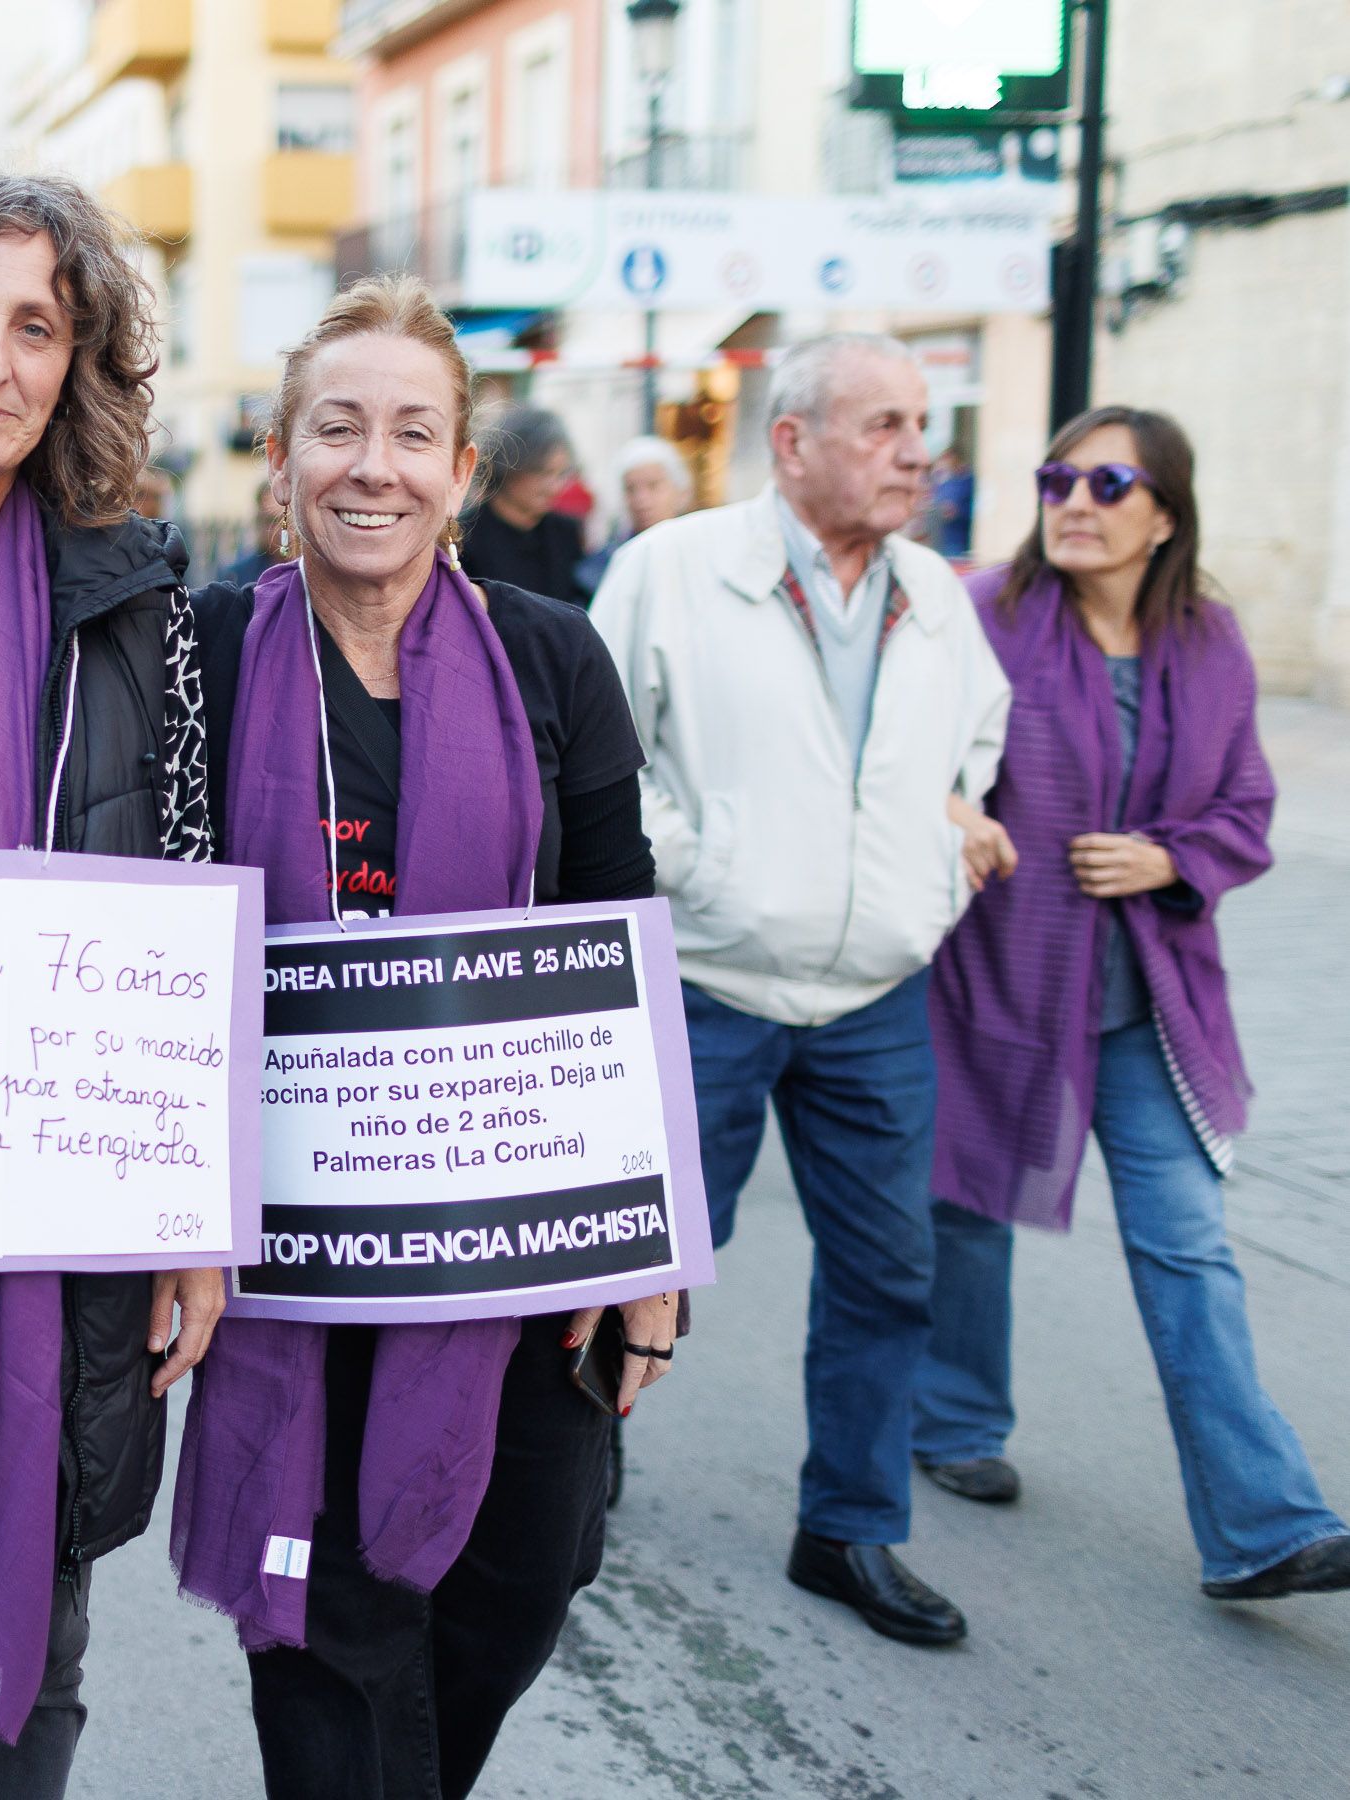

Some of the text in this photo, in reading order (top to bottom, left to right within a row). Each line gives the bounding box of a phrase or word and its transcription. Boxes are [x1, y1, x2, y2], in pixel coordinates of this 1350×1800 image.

[39, 933, 103, 992] 76
[117, 950, 207, 999] años
[343, 958, 443, 987] ITURRI
[453, 951, 523, 981] AAVE
[534, 949, 559, 973] 25
[564, 939, 624, 970] AÑOS
[30, 1027, 76, 1070] por
[96, 1031, 123, 1055] su
[138, 1033, 223, 1067] marido
[265, 1026, 612, 1074] Apuñalada con un cuchillo de
[337, 1086, 379, 1107] por
[389, 1085, 418, 1100] su
[429, 1070, 543, 1101] expareja.
[551, 1066, 595, 1088] Deja
[602, 1063, 624, 1079] un
[351, 1107, 546, 1136] niño de 2 años.
[33, 1116, 212, 1180] Fuengirola.
[314, 1132, 584, 1172] Palmeras (La Coruña)
[622, 1151, 652, 1174] 2024
[157, 1214, 203, 1240] 2024
[325, 1227, 515, 1265] VIOLENCIA
[519, 1201, 667, 1255] MACHISTA
